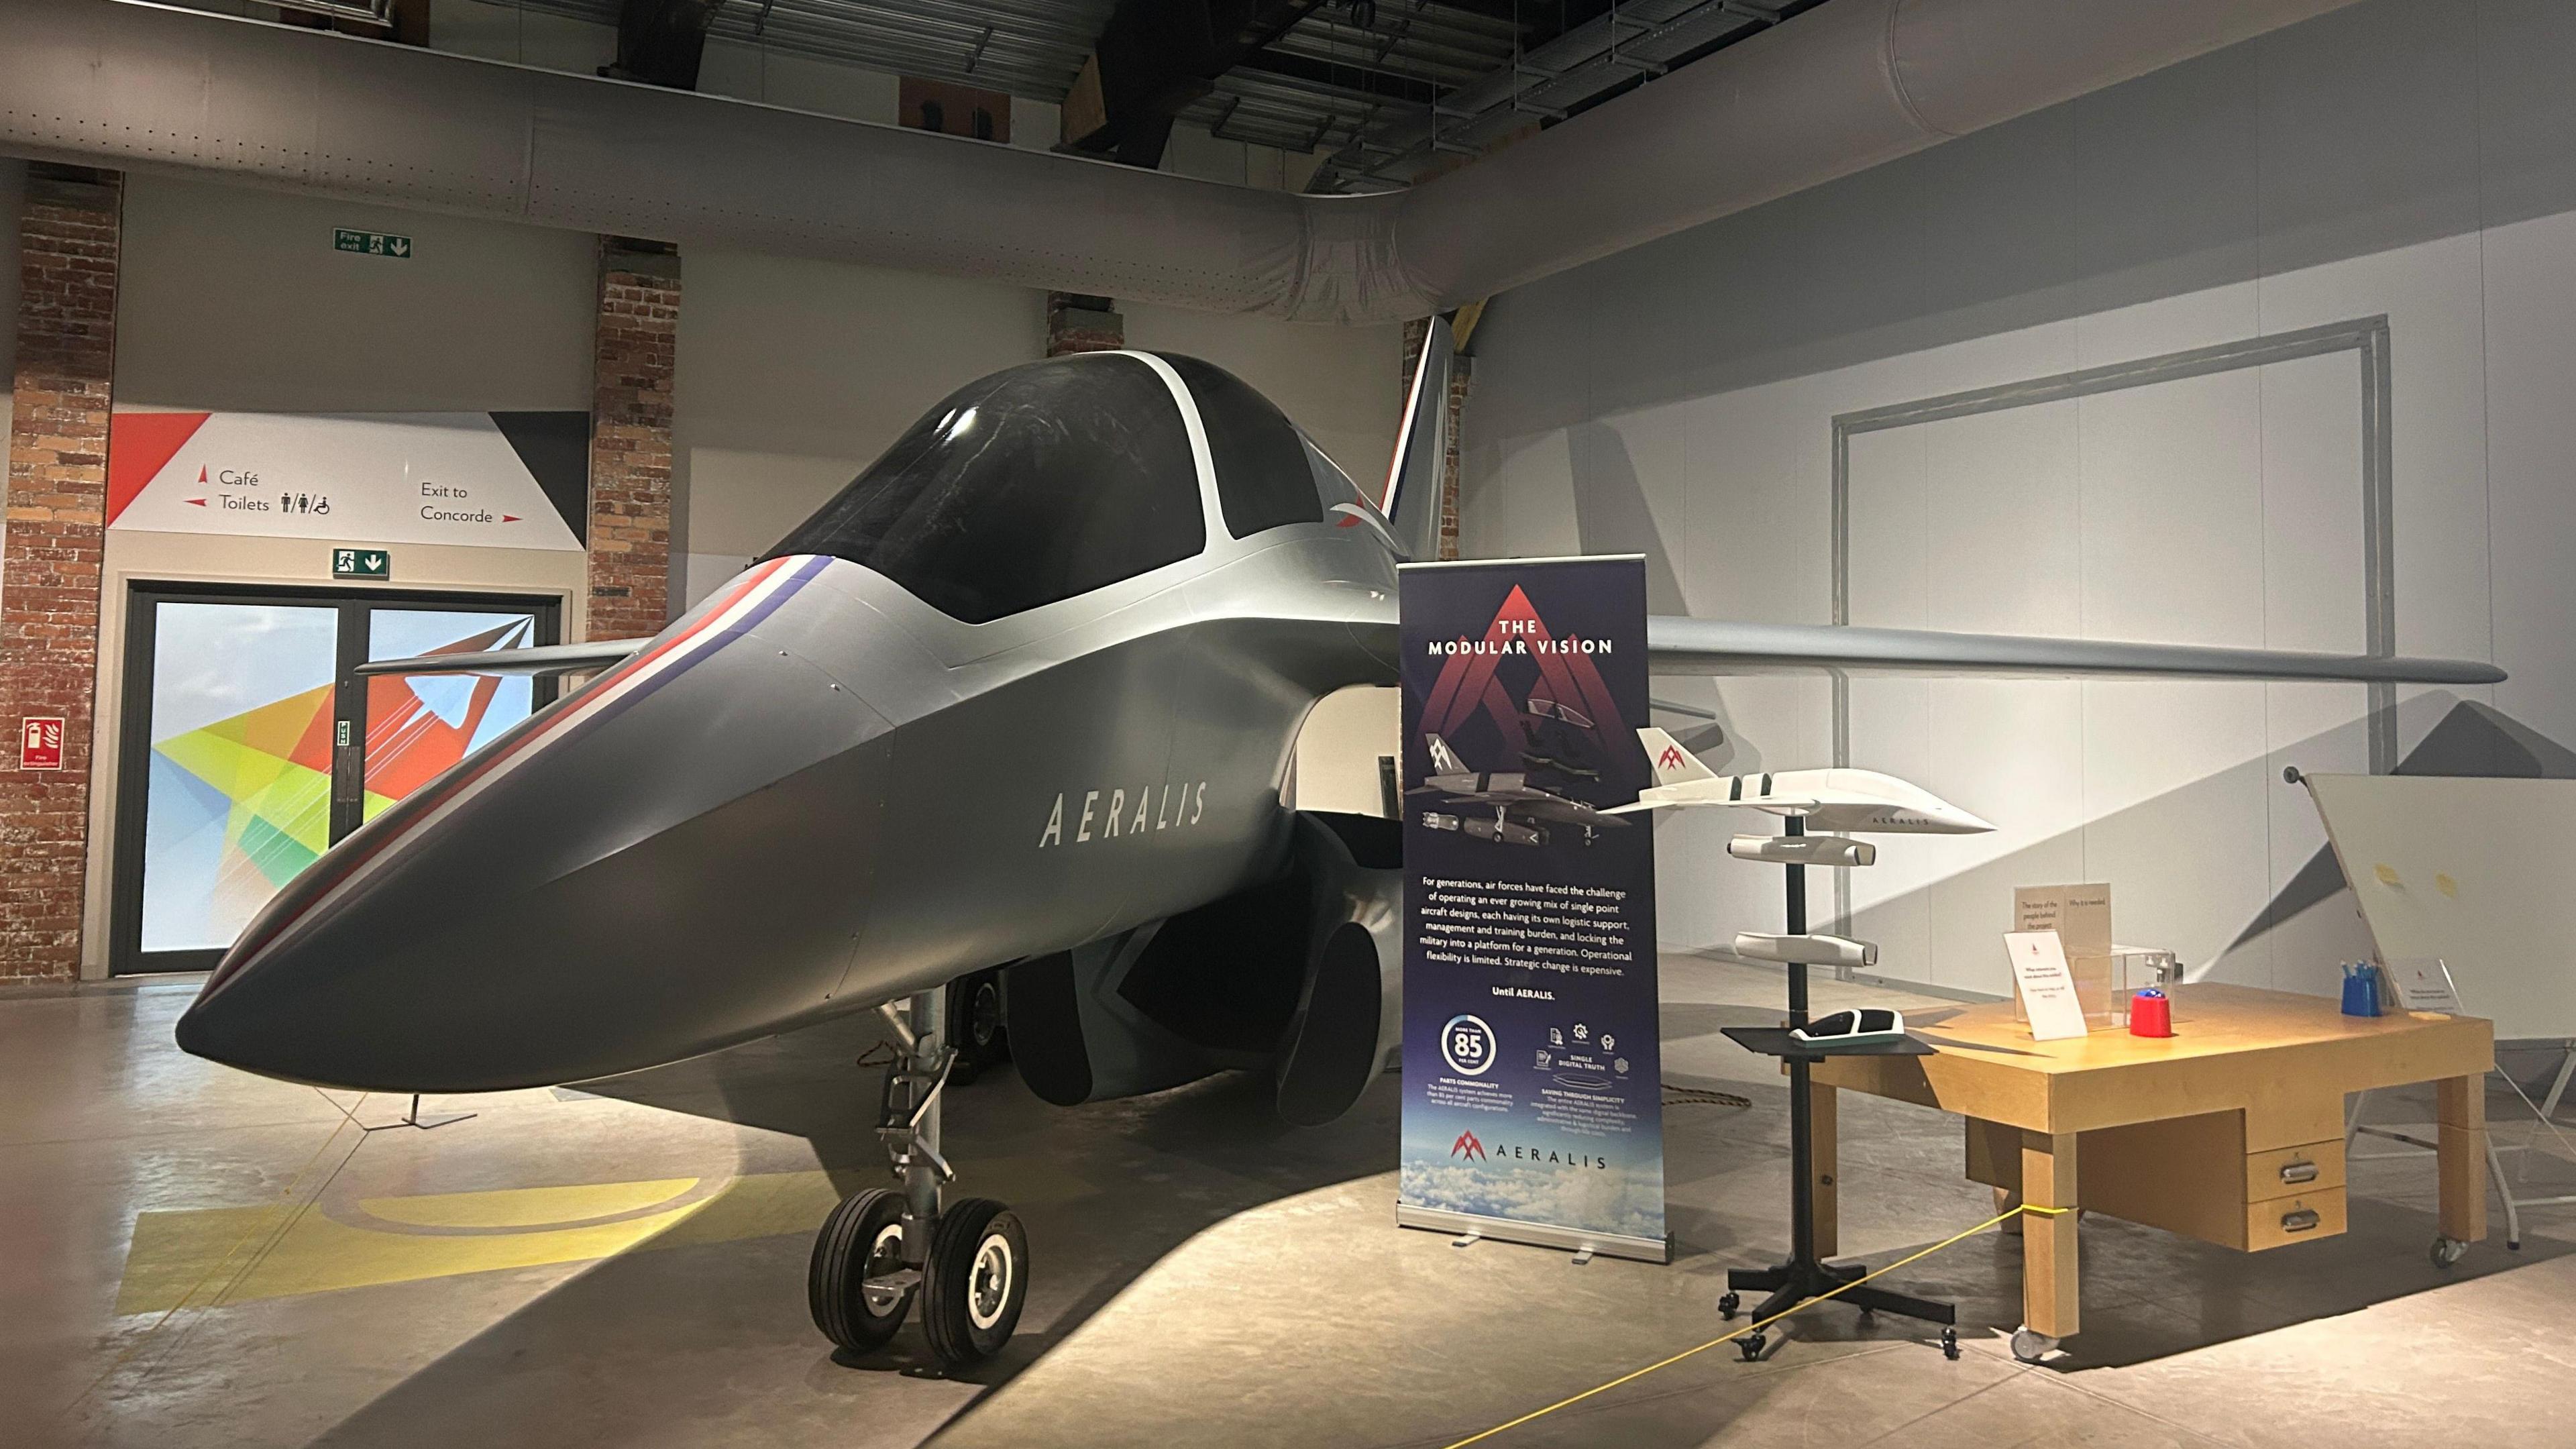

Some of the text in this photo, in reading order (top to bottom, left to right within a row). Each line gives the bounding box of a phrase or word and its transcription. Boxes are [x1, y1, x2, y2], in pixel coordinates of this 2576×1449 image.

[340, 231, 361, 241] Fire
[340, 243, 360, 251] exit
[219, 470, 259, 486] Café
[421, 482, 468, 498] Exit to
[219, 494, 270, 511] Toilets
[421, 505, 493, 523] Concorde
[1499, 620, 1536, 633] THE
[1428, 639, 1612, 655] MODULAR VISION
[1038, 781, 1206, 848] AERALIS
[1872, 817, 1929, 825] AERALIS
[1423, 877, 1626, 900] For generations, air forces have faced the challenge
[1428, 892, 1438, 901] of
[1438, 894, 1476, 906] operating
[1509, 898, 1542, 909] growing
[1543, 900, 1558, 909] mix
[1560, 901, 1569, 910] of
[1570, 902, 1594, 914] single
[1596, 905, 1619, 914] point
[1421, 906, 1448, 916] aircraft
[1449, 908, 1480, 920] designs,
[1482, 911, 1501, 920] each
[1503, 911, 1529, 924] having
[1531, 914, 1541, 922] its
[1562, 916, 1591, 928] logistic
[1593, 920, 1630, 930] support,
[1426, 922, 1624, 946] management and training burden, and locking the
[1419, 935, 1448, 948] military
[1450, 938, 1466, 947] into
[1474, 940, 1510, 951] platform
[1512, 942, 1525, 951] for
[1534, 945, 1578, 955] generation.
[1580, 949, 1632, 961] Operational
[1426, 950, 1624, 976] flexibility is limited. Strategic change is expensive.
[1492, 986, 1555, 1000] Until AERALIS.
[1454, 1033, 1483, 1058] 85
[1558, 1060, 1582, 1069] DIGITAL
[1585, 1063, 1605, 1071] TRUTH
[1570, 1055, 1593, 1063] SINGLE
[1457, 1079, 1499, 1089] COMMONALITY
[1563, 1091, 1591, 1100] THROUGH
[1592, 1095, 1625, 1104] SIMPLICITY
[1496, 1144, 1605, 1169] AERALIS
